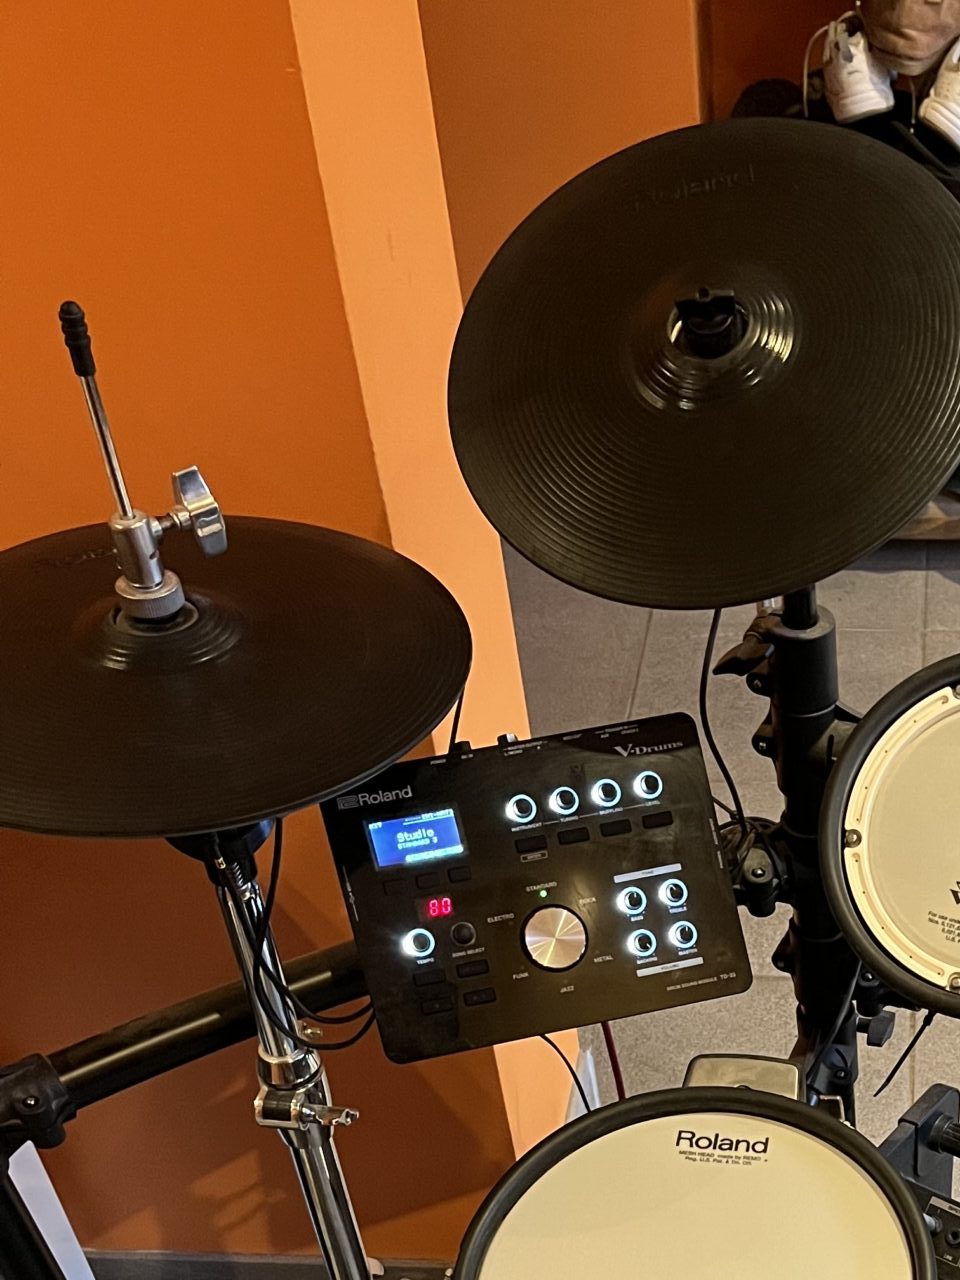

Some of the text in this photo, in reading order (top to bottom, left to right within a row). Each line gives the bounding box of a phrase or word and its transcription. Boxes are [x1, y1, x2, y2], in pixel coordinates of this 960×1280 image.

[614, 740, 684, 758] V-Drums
[358, 784, 413, 807] Roland
[396, 827, 435, 843] Studio
[525, 881, 557, 892] STANDARD
[487, 913, 515, 924] ELECTRO
[675, 1130, 770, 1154] Roland
